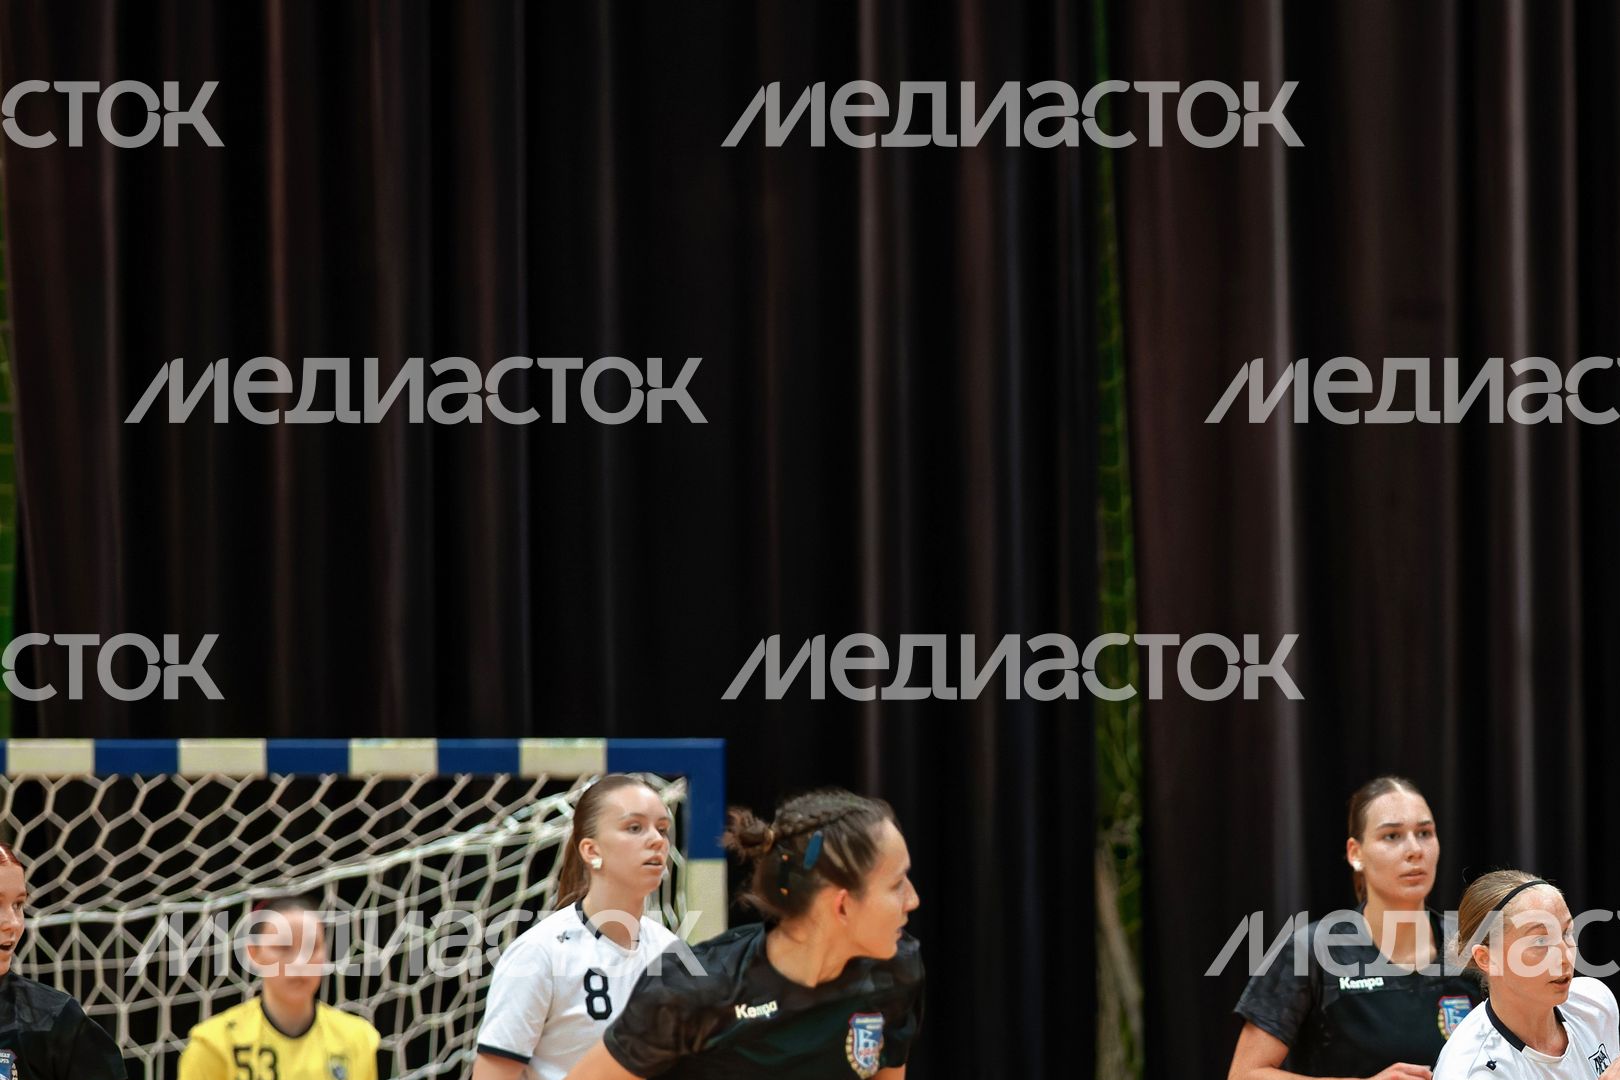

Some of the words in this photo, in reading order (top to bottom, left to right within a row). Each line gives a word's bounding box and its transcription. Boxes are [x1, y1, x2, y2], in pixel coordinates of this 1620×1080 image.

[1339, 976, 1384, 991] Kempa
[583, 967, 612, 1020] 8
[734, 1000, 778, 1019] Kempa
